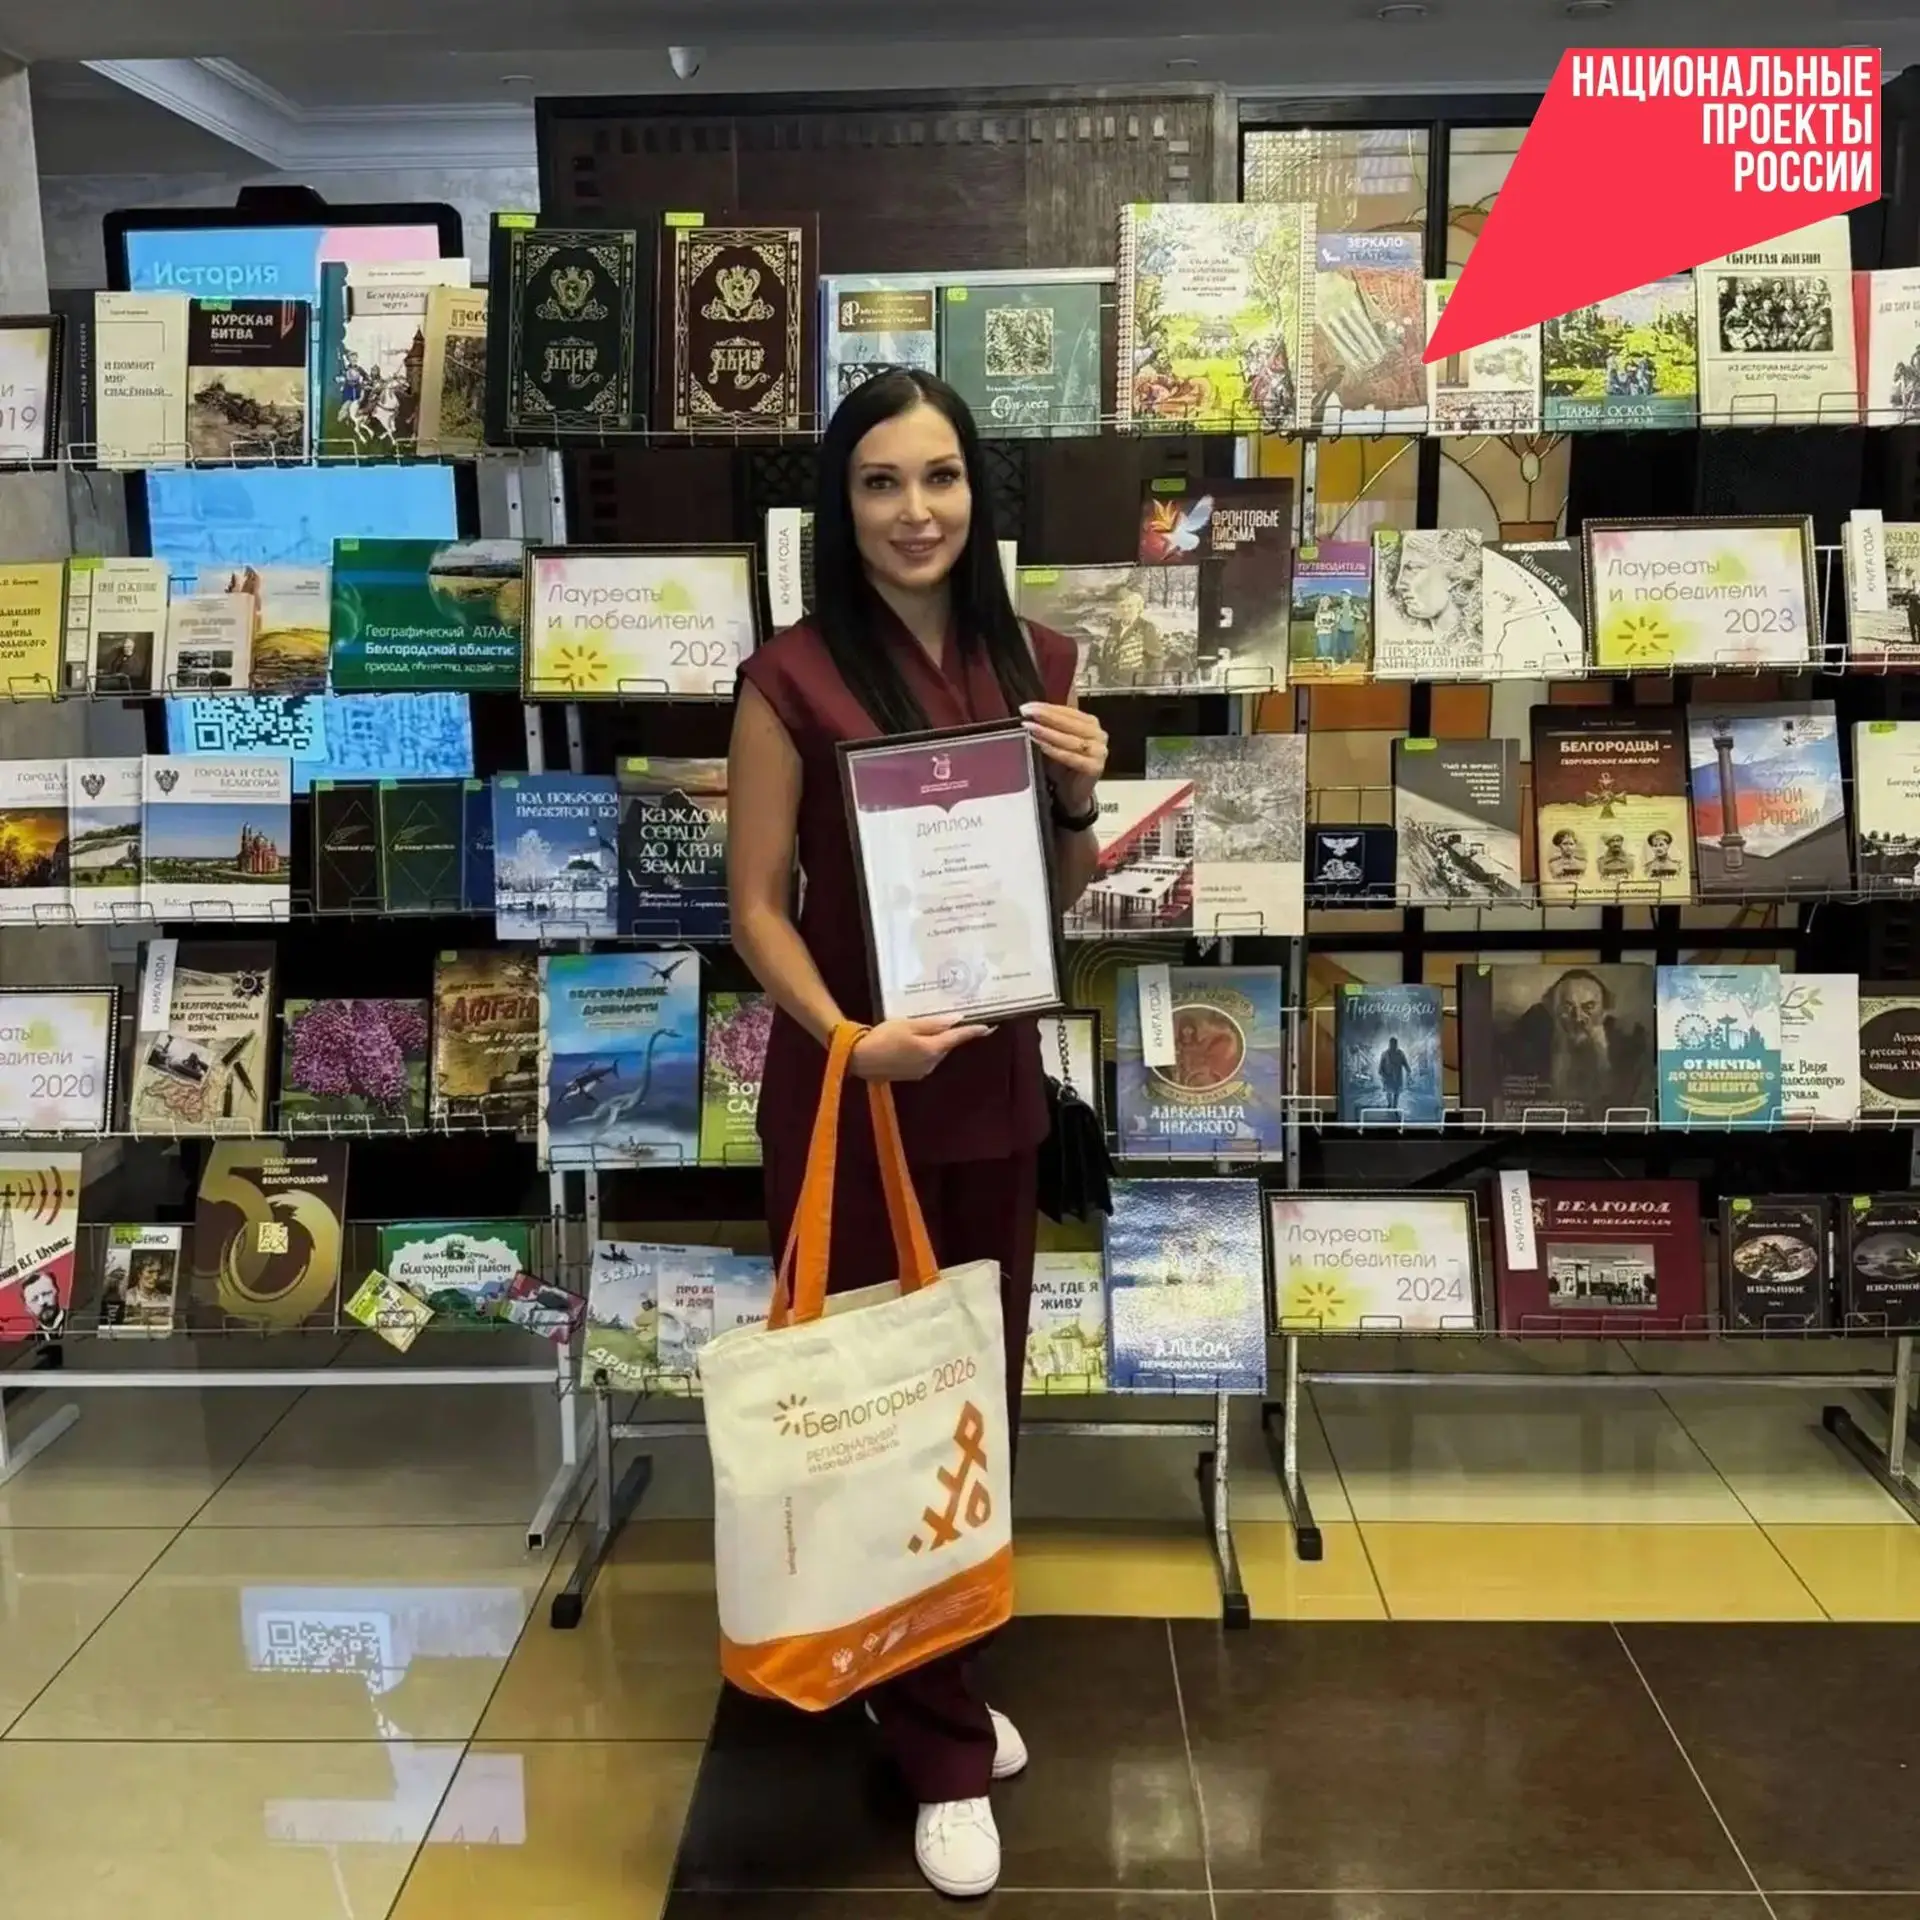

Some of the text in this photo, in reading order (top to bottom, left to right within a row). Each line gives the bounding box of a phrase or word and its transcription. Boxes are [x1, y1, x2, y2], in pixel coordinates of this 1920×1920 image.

[1346, 237, 1404, 249] ЗЕРКАЛО
[154, 260, 280, 292] История
[211, 314, 274, 327] КУРСКАЯ
[210, 328, 254, 340] БИТВА
[1212, 510, 1279, 527] ФРОНТОВЫЕ
[1212, 527, 1256, 542] ПИСЬМА
[1608, 558, 1721, 581] Лауреаты
[548, 584, 665, 606] Лауреаты
[1609, 587, 1624, 602] и
[1635, 581, 1768, 601] победители
[548, 608, 715, 630] и победители
[1725, 608, 1797, 634] 2023
[365, 623, 515, 638] Географический АТЛАС
[365, 642, 457, 657] Белгородской
[1560, 740, 1660, 754] БЕЛГОРОДЦЫ
[195, 768, 236, 778] ГОРОДА
[917, 815, 984, 838] ДИПЛОМ
[1684, 1058, 1762, 1070] ОТ МЕЧТЫ
[1799, 1059, 1828, 1076] Варя
[31, 1073, 95, 1099] 2020
[1150, 1104, 1245, 1119] АЛЕКСАНДРА
[1554, 1200, 1672, 1214] БЕЛГОРОД
[1288, 1224, 1390, 1245] Лауреаты
[1289, 1249, 1437, 1268] и победители
[676, 1285, 699, 1294] ПРО
[1061, 1281, 1086, 1296] ГДЕ
[1089, 1281, 1099, 1292] Я
[1396, 1277, 1464, 1302] 2024
[675, 1298, 684, 1307] И
[1041, 1297, 1083, 1310] ЖИВУ
[1153, 1336, 1230, 1359] АЛЬБОМ
[803, 1355, 977, 1438] Белогорье 2026
